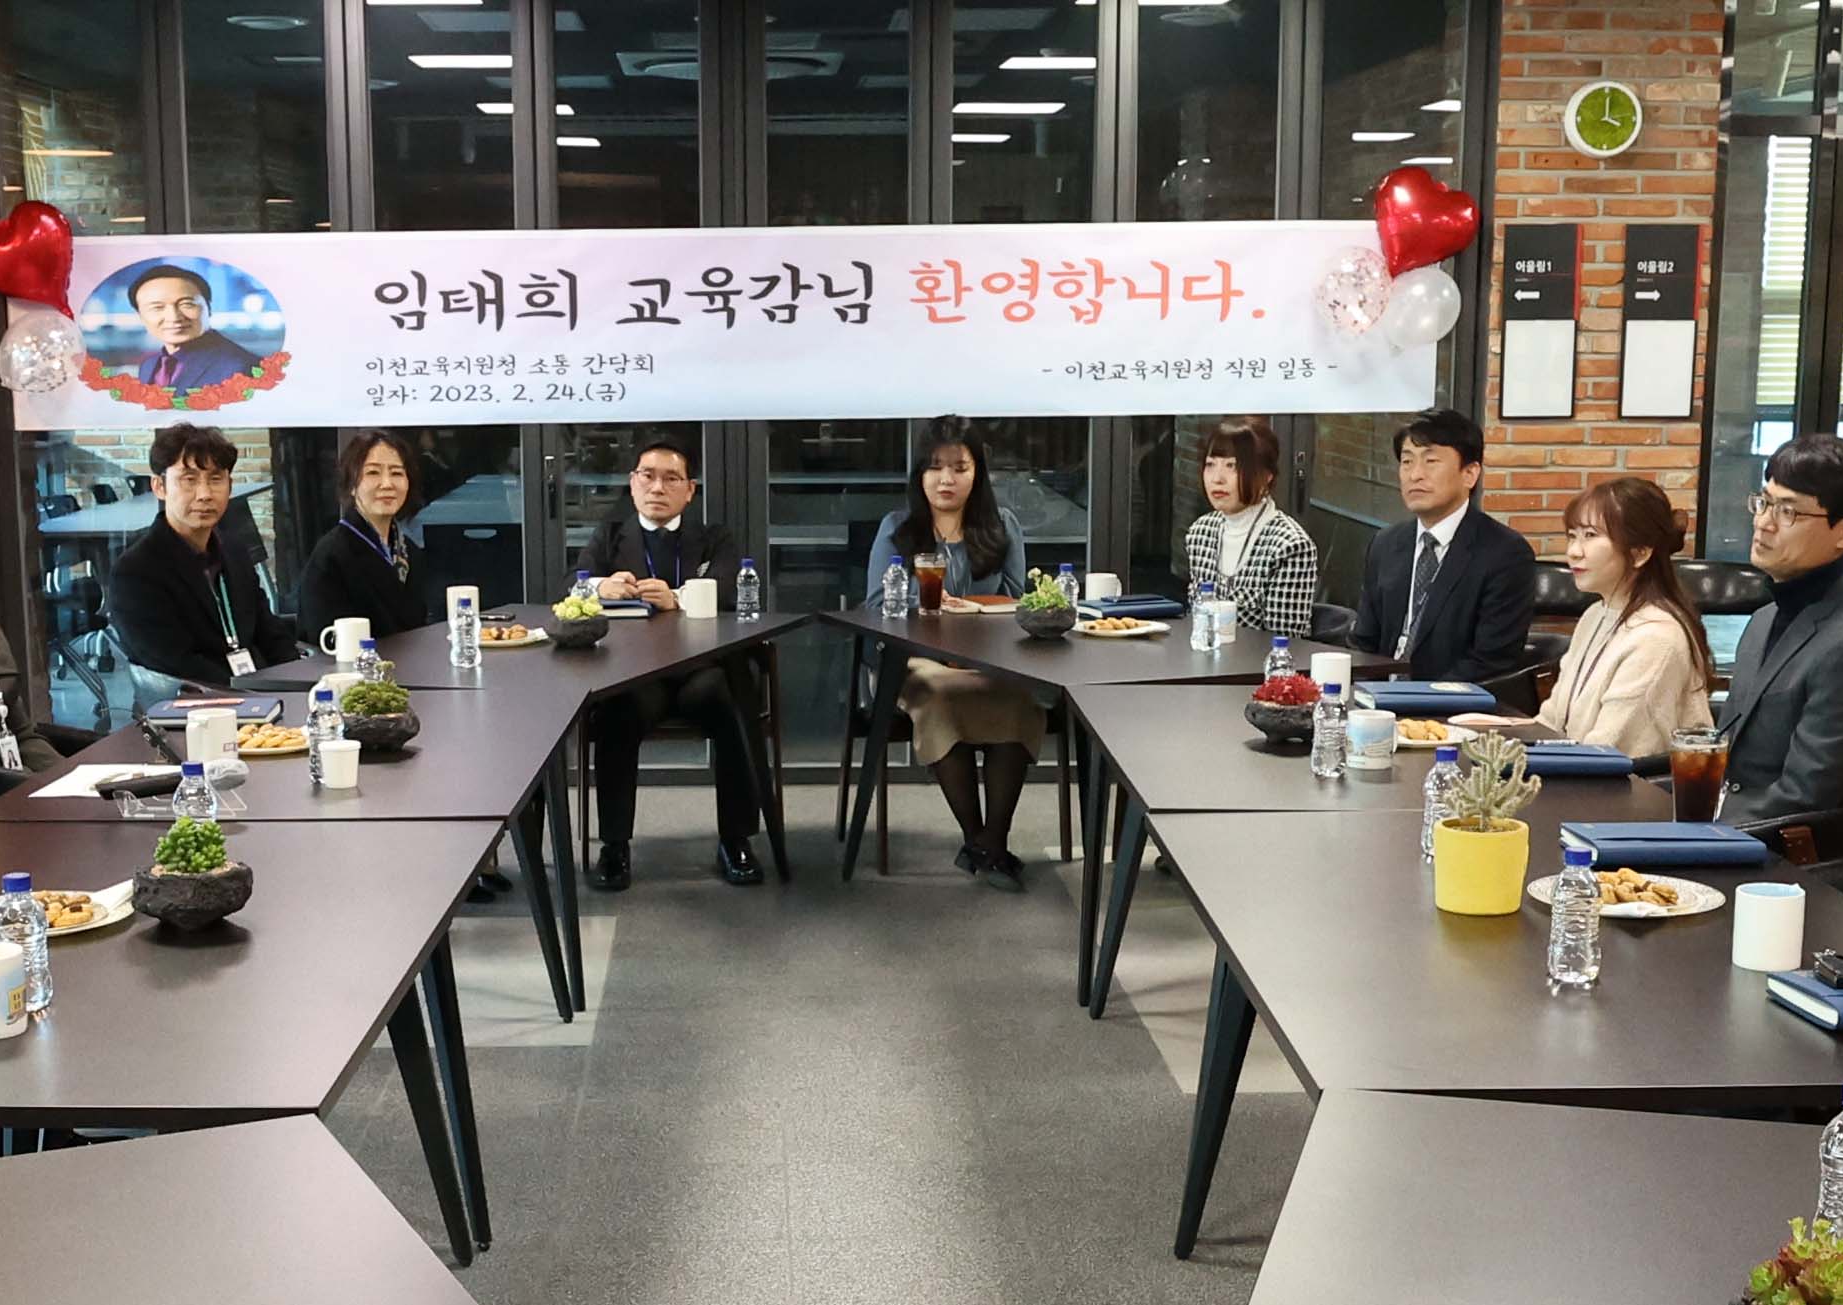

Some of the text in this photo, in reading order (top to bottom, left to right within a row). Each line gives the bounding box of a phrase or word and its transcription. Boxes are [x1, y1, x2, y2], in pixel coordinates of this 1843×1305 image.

[374, 258, 1266, 332] 임태희 교육감님 환영합니다.
[365, 353, 655, 377] 이천교육지원청 소통 간담회
[1065, 358, 1214, 381] 이천교육지원청
[1226, 358, 1267, 380] 직원
[1278, 358, 1316, 380] 일동
[366, 381, 627, 406] 일자: 2023. 2. 24.(금)
